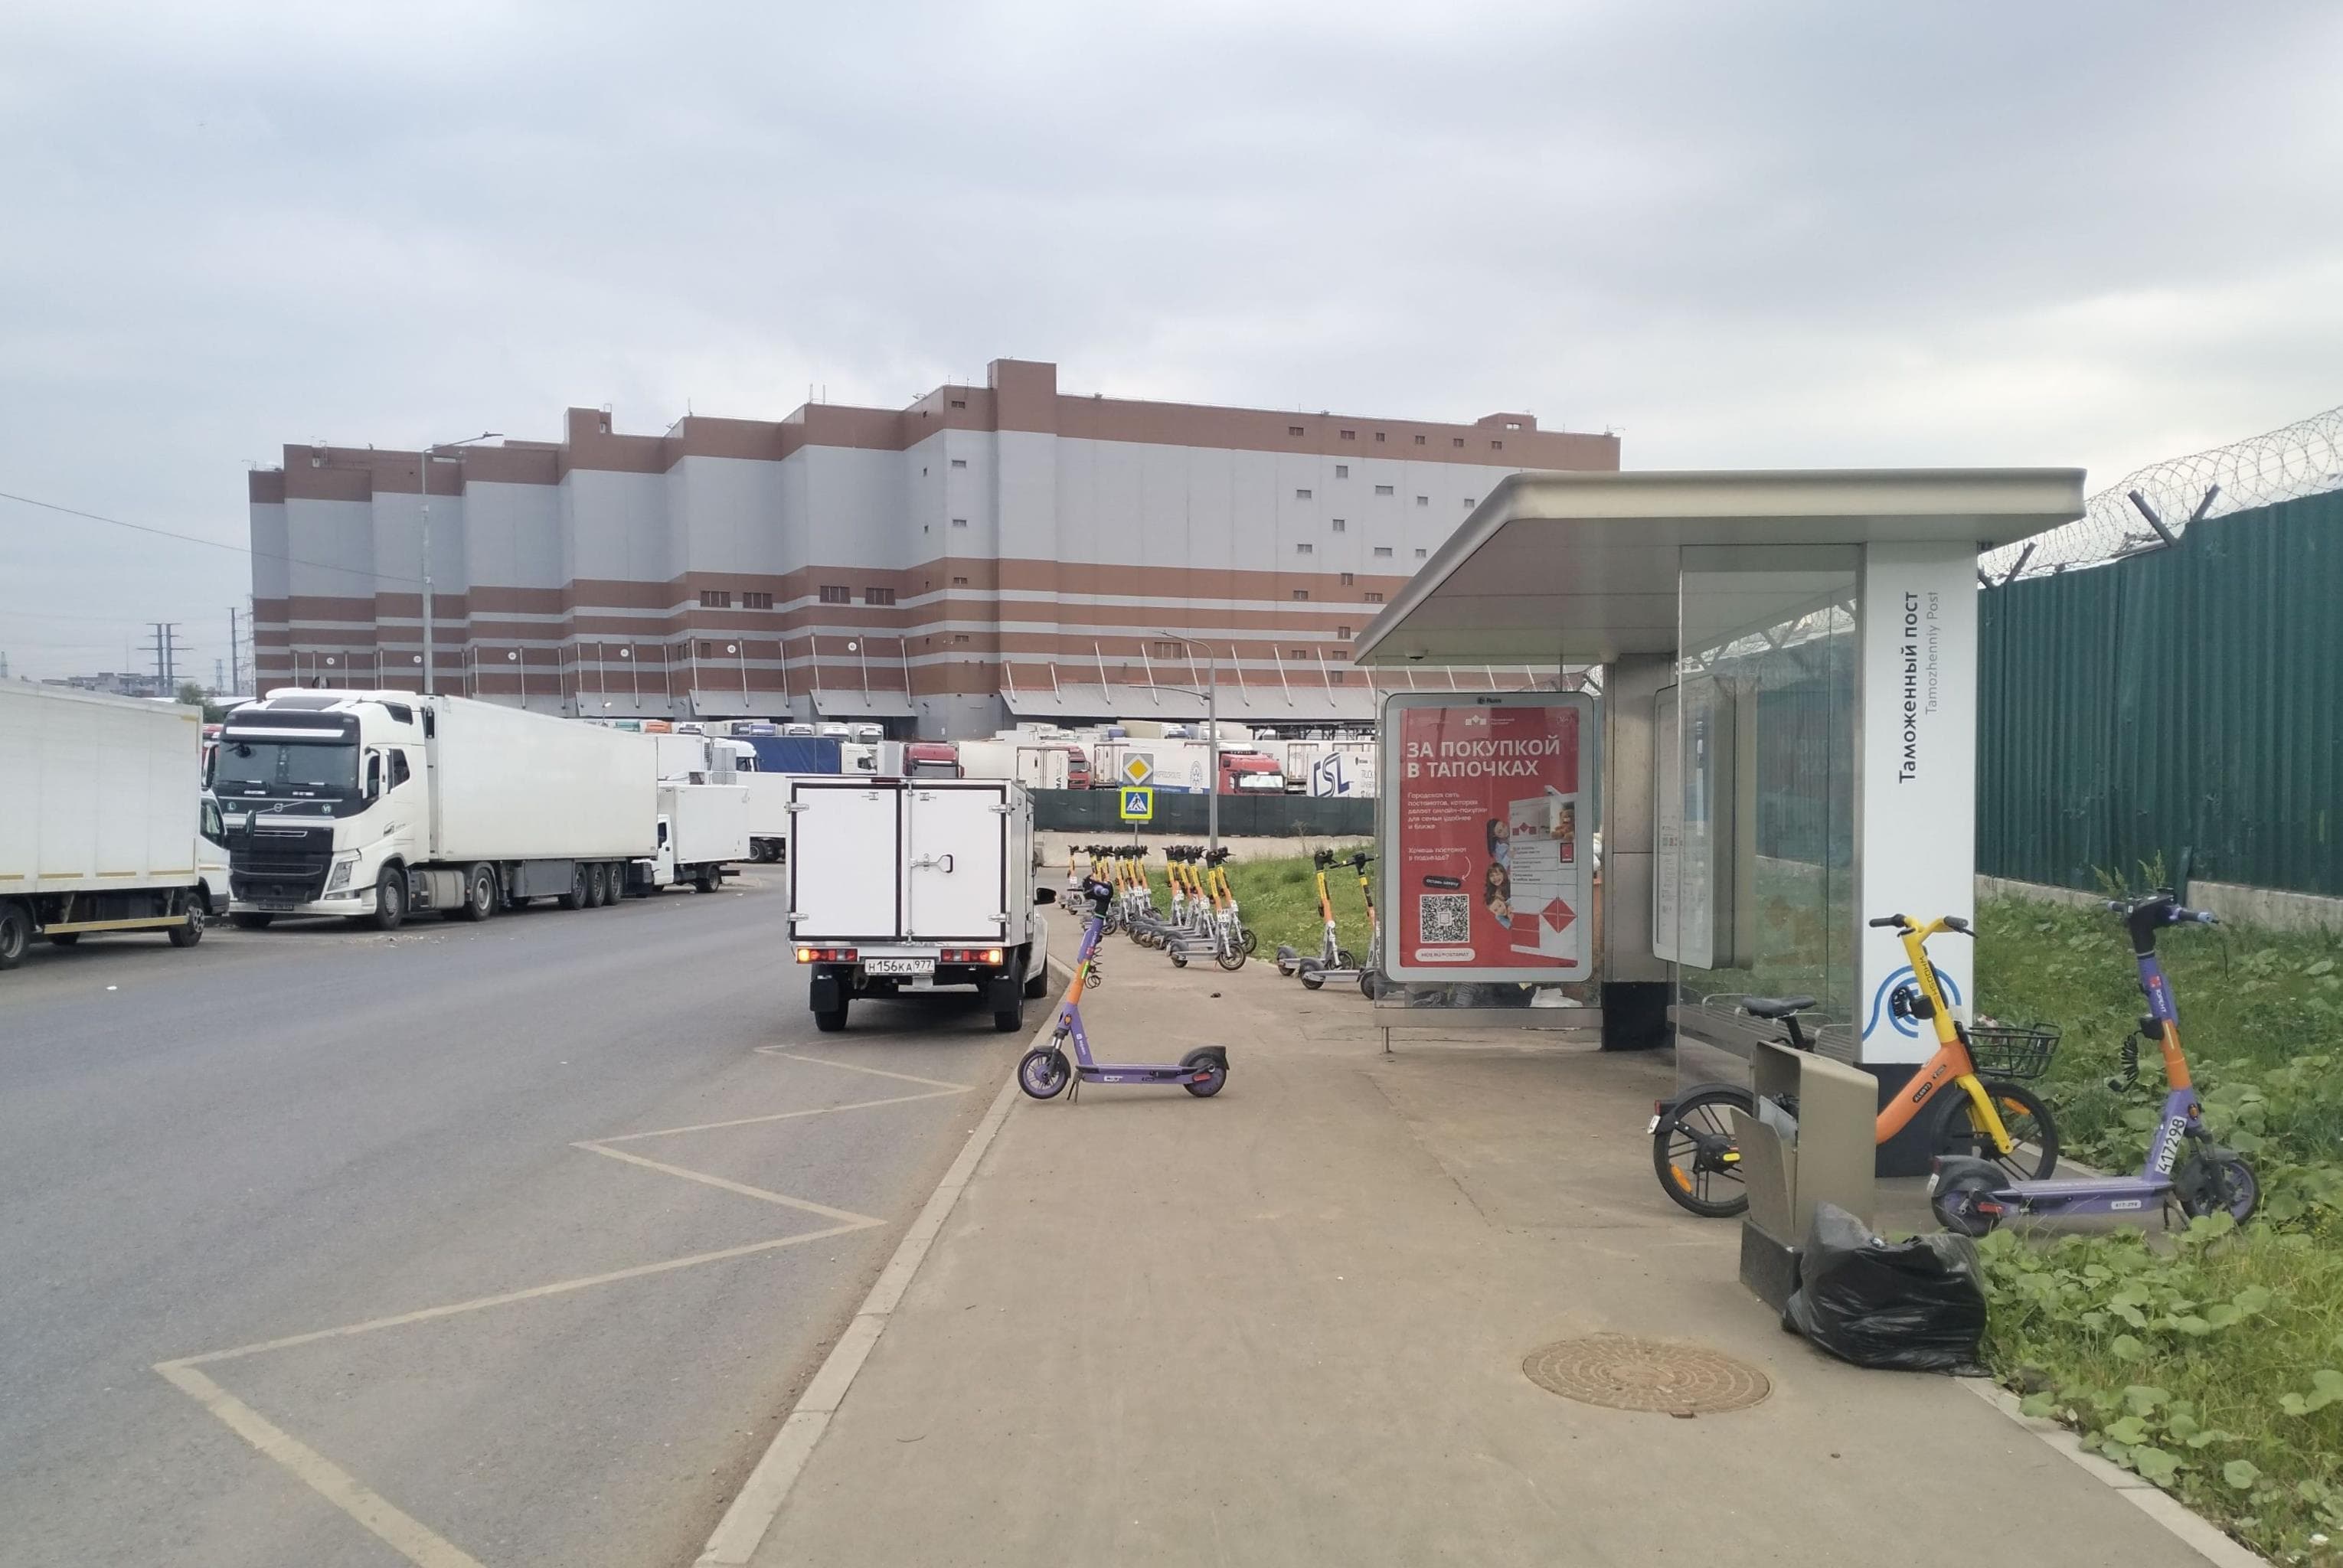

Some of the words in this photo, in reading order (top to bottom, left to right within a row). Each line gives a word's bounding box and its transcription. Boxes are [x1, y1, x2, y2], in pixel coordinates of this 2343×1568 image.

[1904, 592, 1918, 638] пост
[1926, 592, 1939, 620] Post
[1926, 625, 1940, 715] Tamozhenniy
[1899, 645, 1917, 784] Таможенный
[1407, 742, 1434, 758] ЗА
[1441, 734, 1560, 757] ПОКУПКОЙ
[1407, 762, 1420, 778] В
[1426, 760, 1539, 777] ТАПОЧКАХ
[1920, 956, 1938, 995] WHOOSH
[2157, 1119, 2185, 1172] 417298
